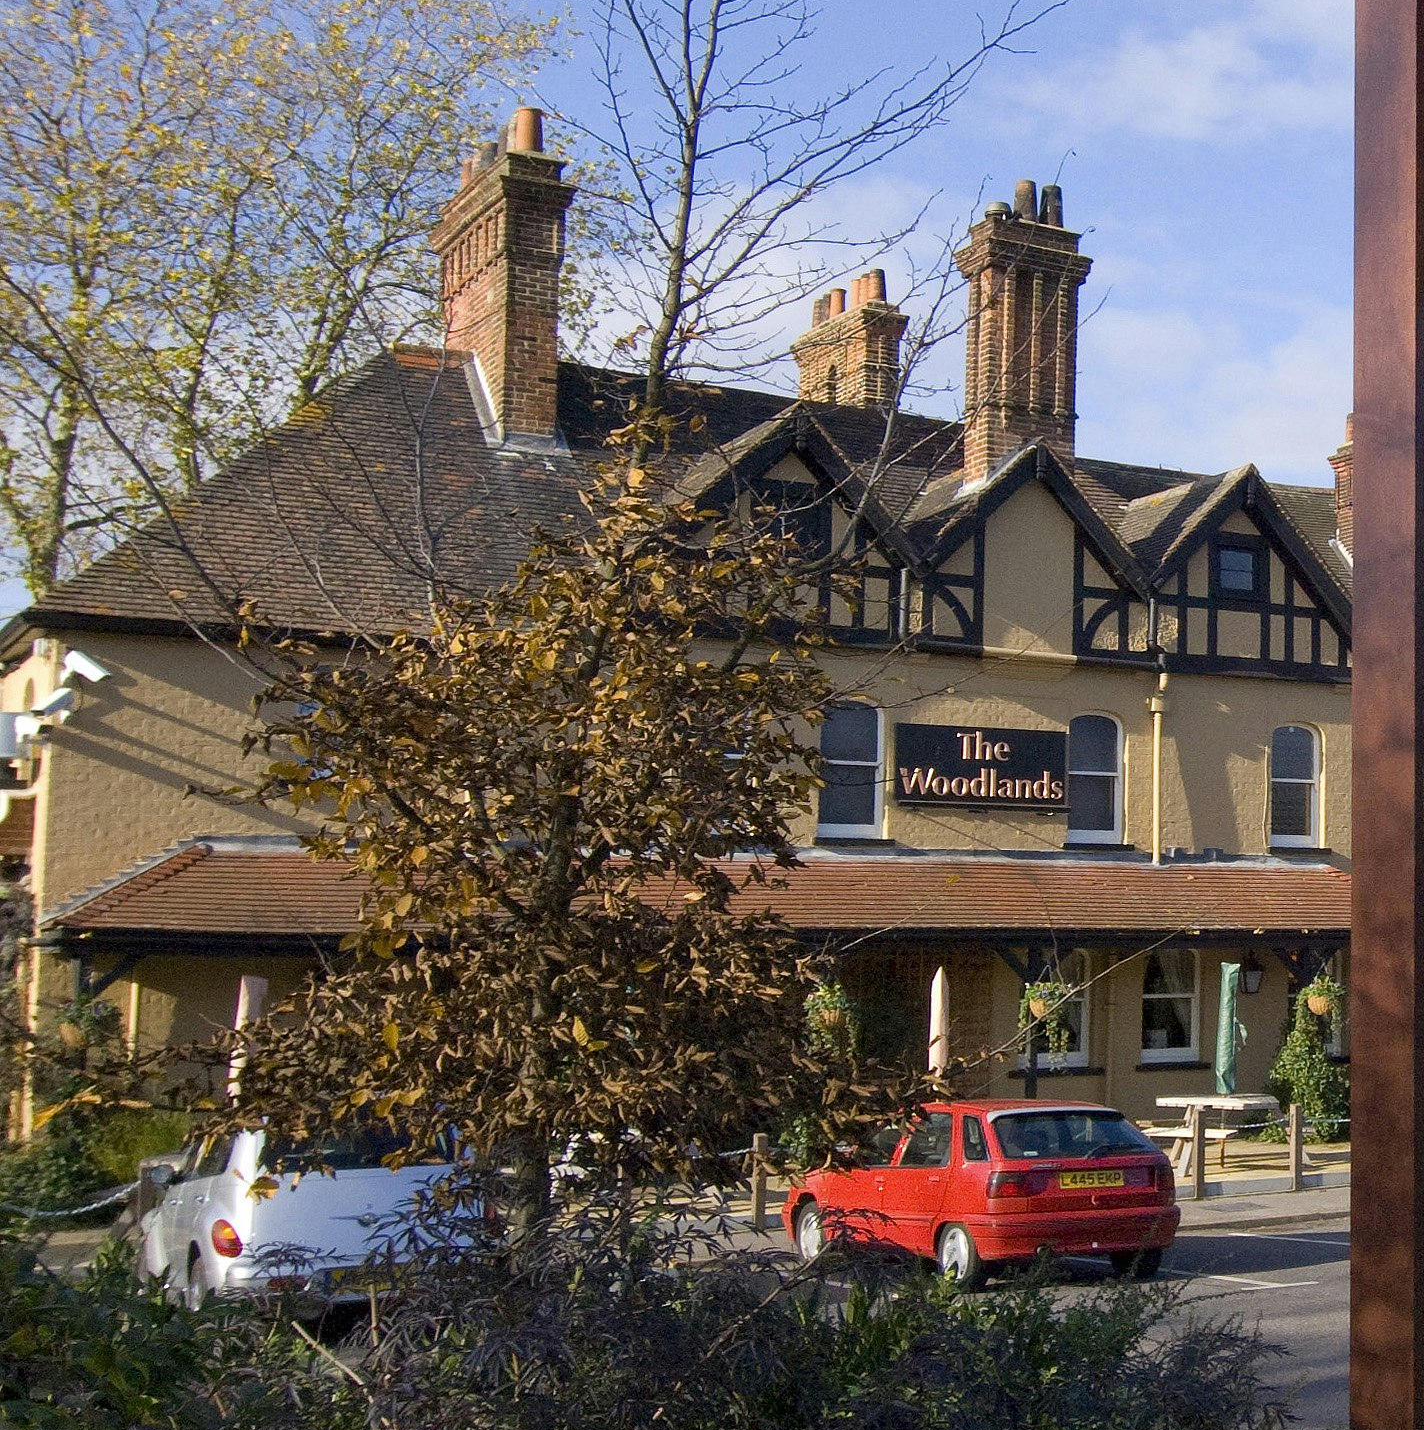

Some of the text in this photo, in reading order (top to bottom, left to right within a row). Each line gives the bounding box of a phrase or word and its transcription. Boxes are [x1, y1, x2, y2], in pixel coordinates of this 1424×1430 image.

[956, 731, 1011, 762] The
[900, 767, 1064, 800] Woodlands
[1061, 1172, 1121, 1186] L445 EKP
